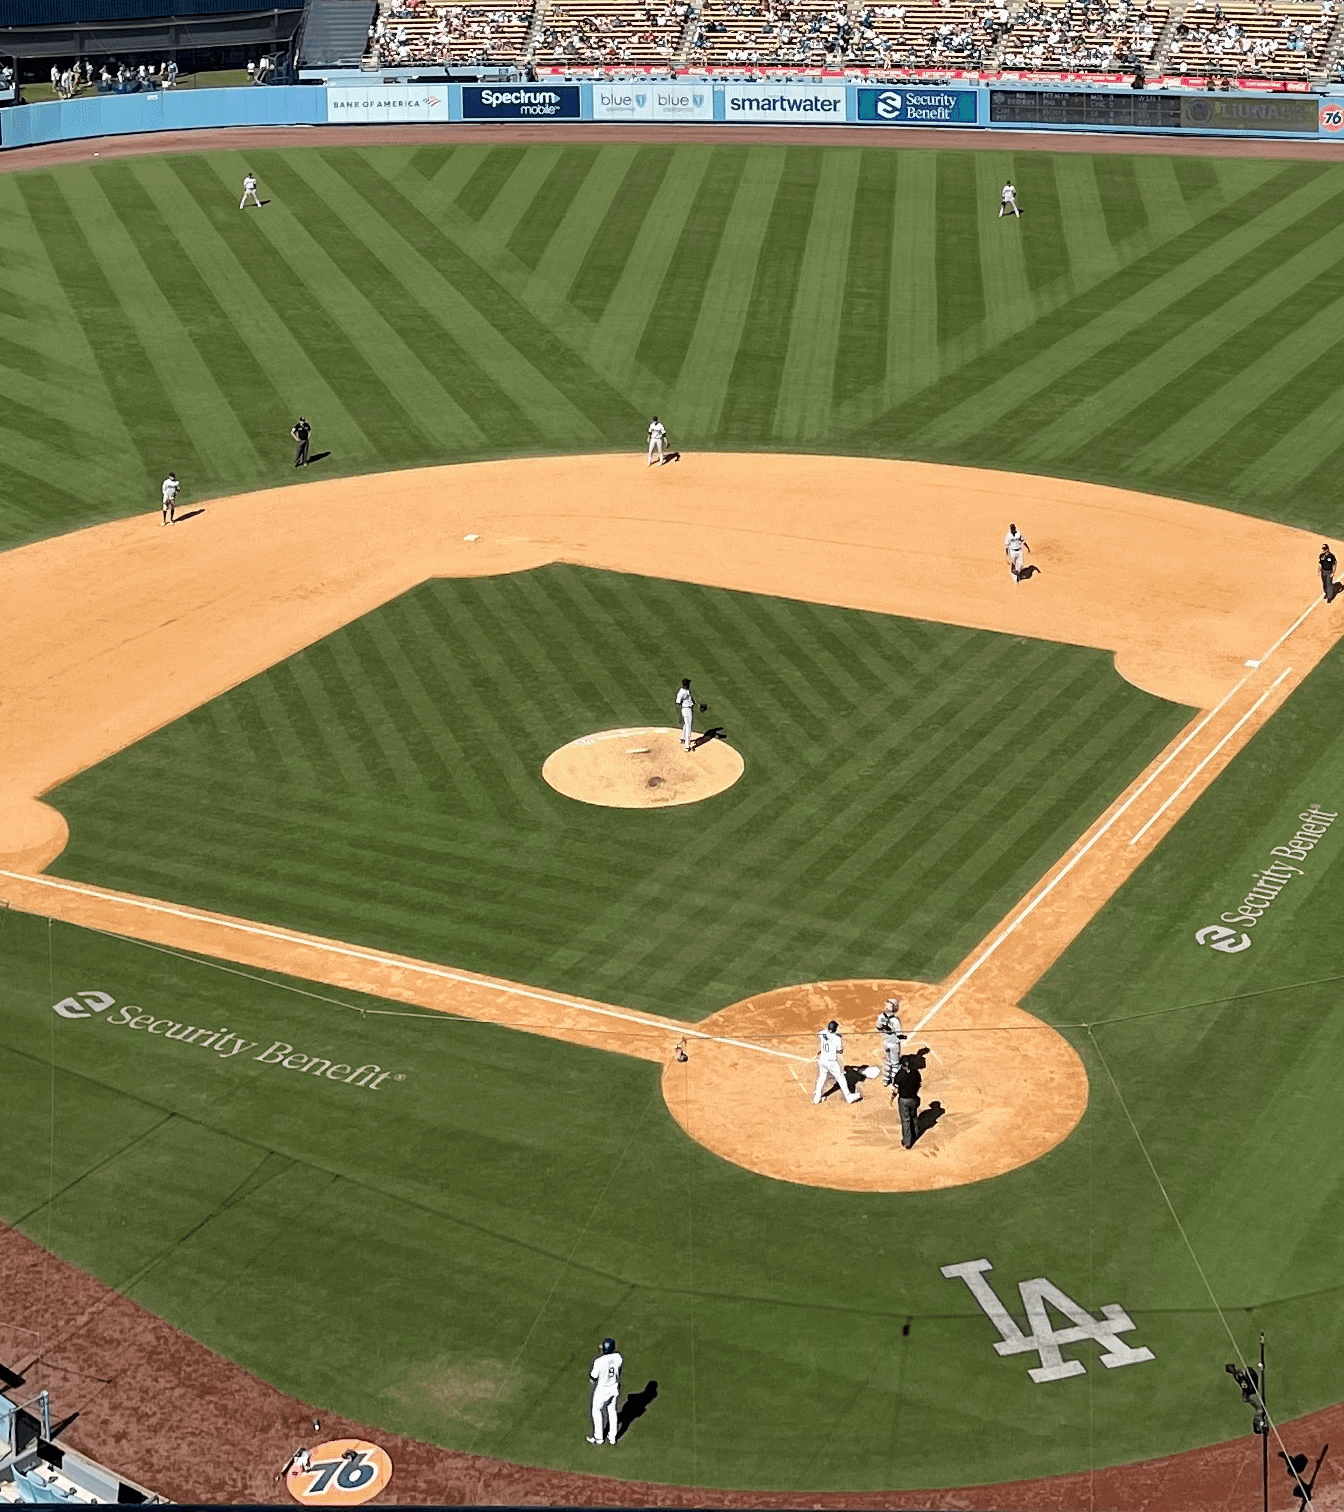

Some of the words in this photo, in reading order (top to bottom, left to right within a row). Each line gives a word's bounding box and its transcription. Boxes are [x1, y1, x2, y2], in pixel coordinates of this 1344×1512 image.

[333, 101, 360, 109] BANK
[377, 100, 420, 108] AMERICA
[481, 89, 555, 107] Spectrum
[601, 93, 632, 107] blue
[657, 93, 690, 107] blue
[730, 96, 841, 115] smartwater
[905, 92, 957, 109] Security
[520, 104, 556, 115] mobile
[906, 105, 952, 120] Benefit
[1321, 111, 1344, 126] 76
[1220, 859, 1305, 928] Security
[1269, 805, 1339, 863] Benefit
[106, 1005, 257, 1059] Security
[253, 1040, 392, 1091] Benefit
[939, 1257, 1156, 1384] LA
[302, 1449, 380, 1498] 76
